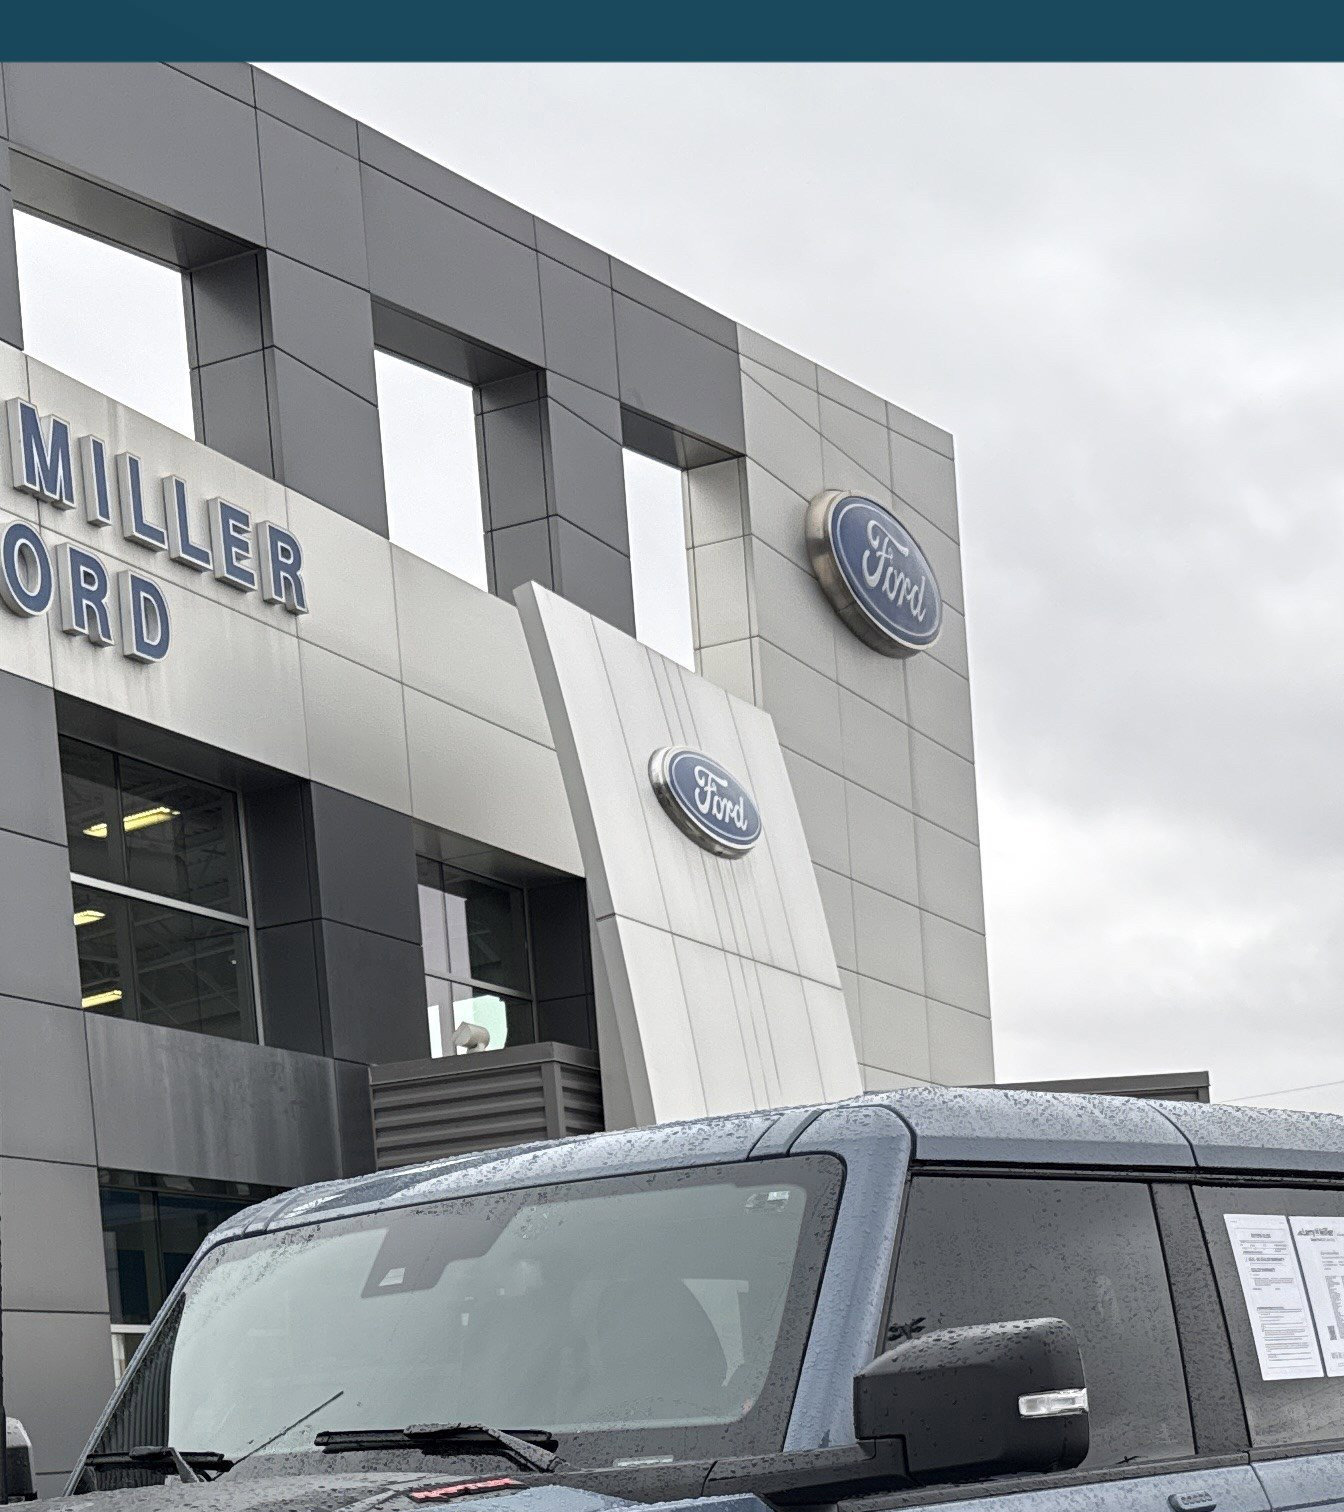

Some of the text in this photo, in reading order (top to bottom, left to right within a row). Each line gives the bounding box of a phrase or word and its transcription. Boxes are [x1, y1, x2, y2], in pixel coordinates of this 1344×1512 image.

[6, 398, 310, 616] MILLER
[861, 518, 929, 624] Ford
[693, 763, 749, 831] Ford
